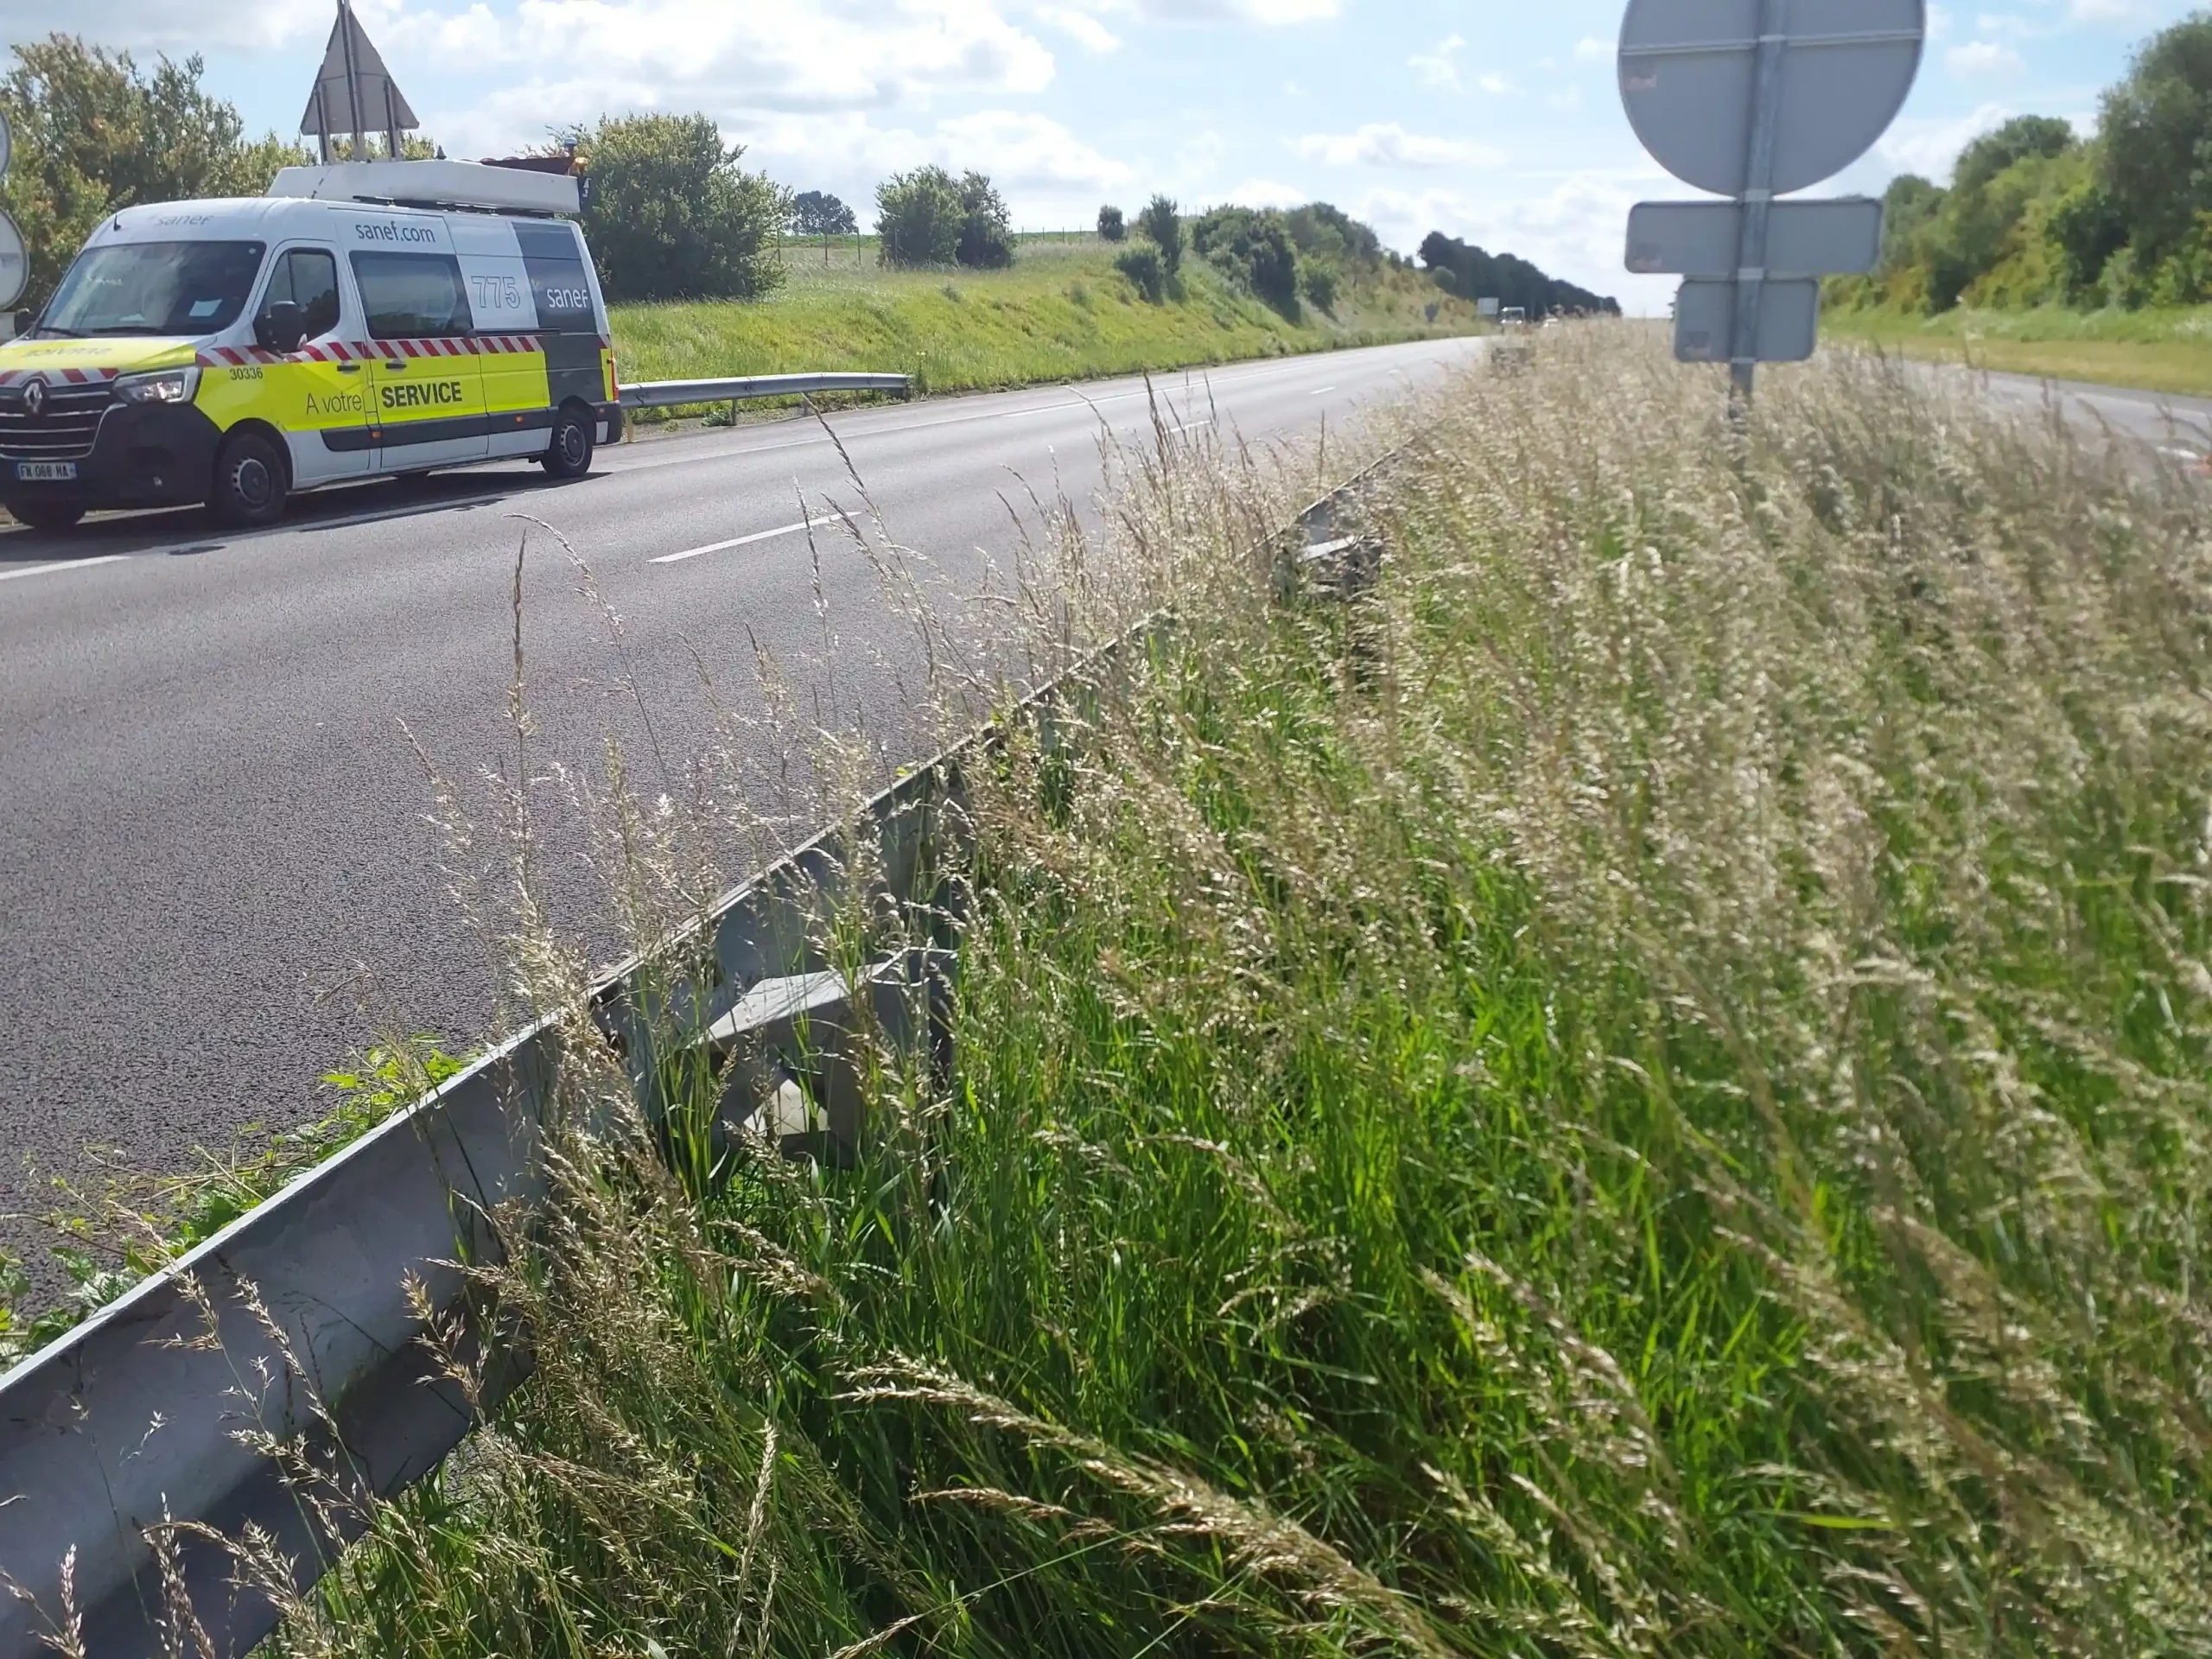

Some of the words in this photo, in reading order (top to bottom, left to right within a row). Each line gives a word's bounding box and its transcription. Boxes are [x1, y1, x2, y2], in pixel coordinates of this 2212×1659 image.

[355, 220, 435, 243] sanef.com
[471, 276, 520, 308] 775
[547, 289, 588, 308] sanef
[229, 367, 264, 380] 30336
[306, 392, 319, 415] A
[322, 391, 363, 414] votre
[381, 382, 462, 409] SERVICE
